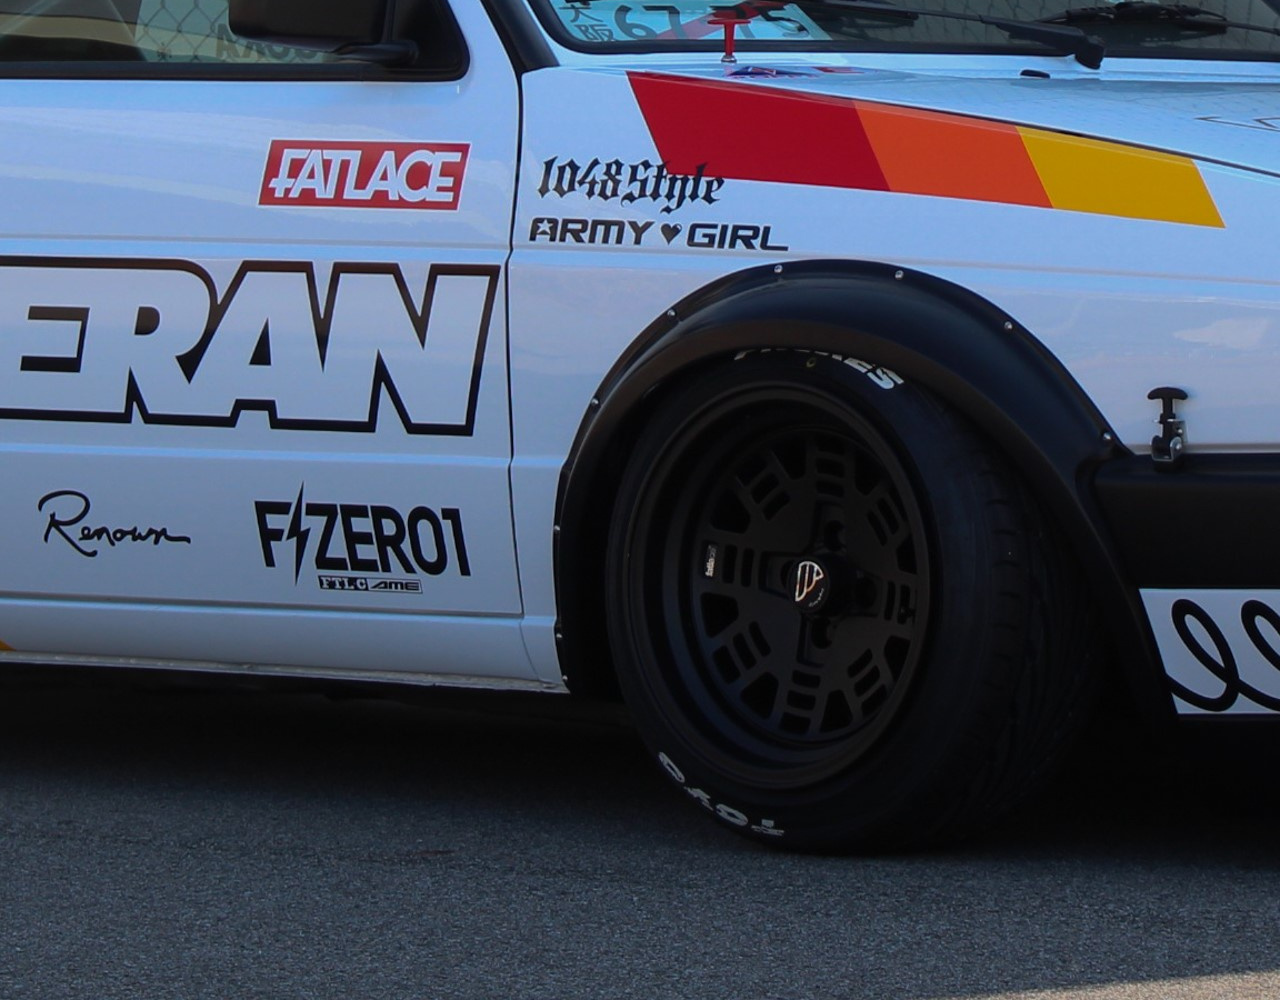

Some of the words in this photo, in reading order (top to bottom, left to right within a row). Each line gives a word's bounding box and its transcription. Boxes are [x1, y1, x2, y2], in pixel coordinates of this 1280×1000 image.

[268, 148, 463, 203] FATLACE
[538, 156, 724, 213] 1048Style
[529, 217, 654, 245] ARMY
[687, 223, 789, 251] GIRL
[37, 490, 191, 557] Renown
[658, 751, 785, 836] TOYO
